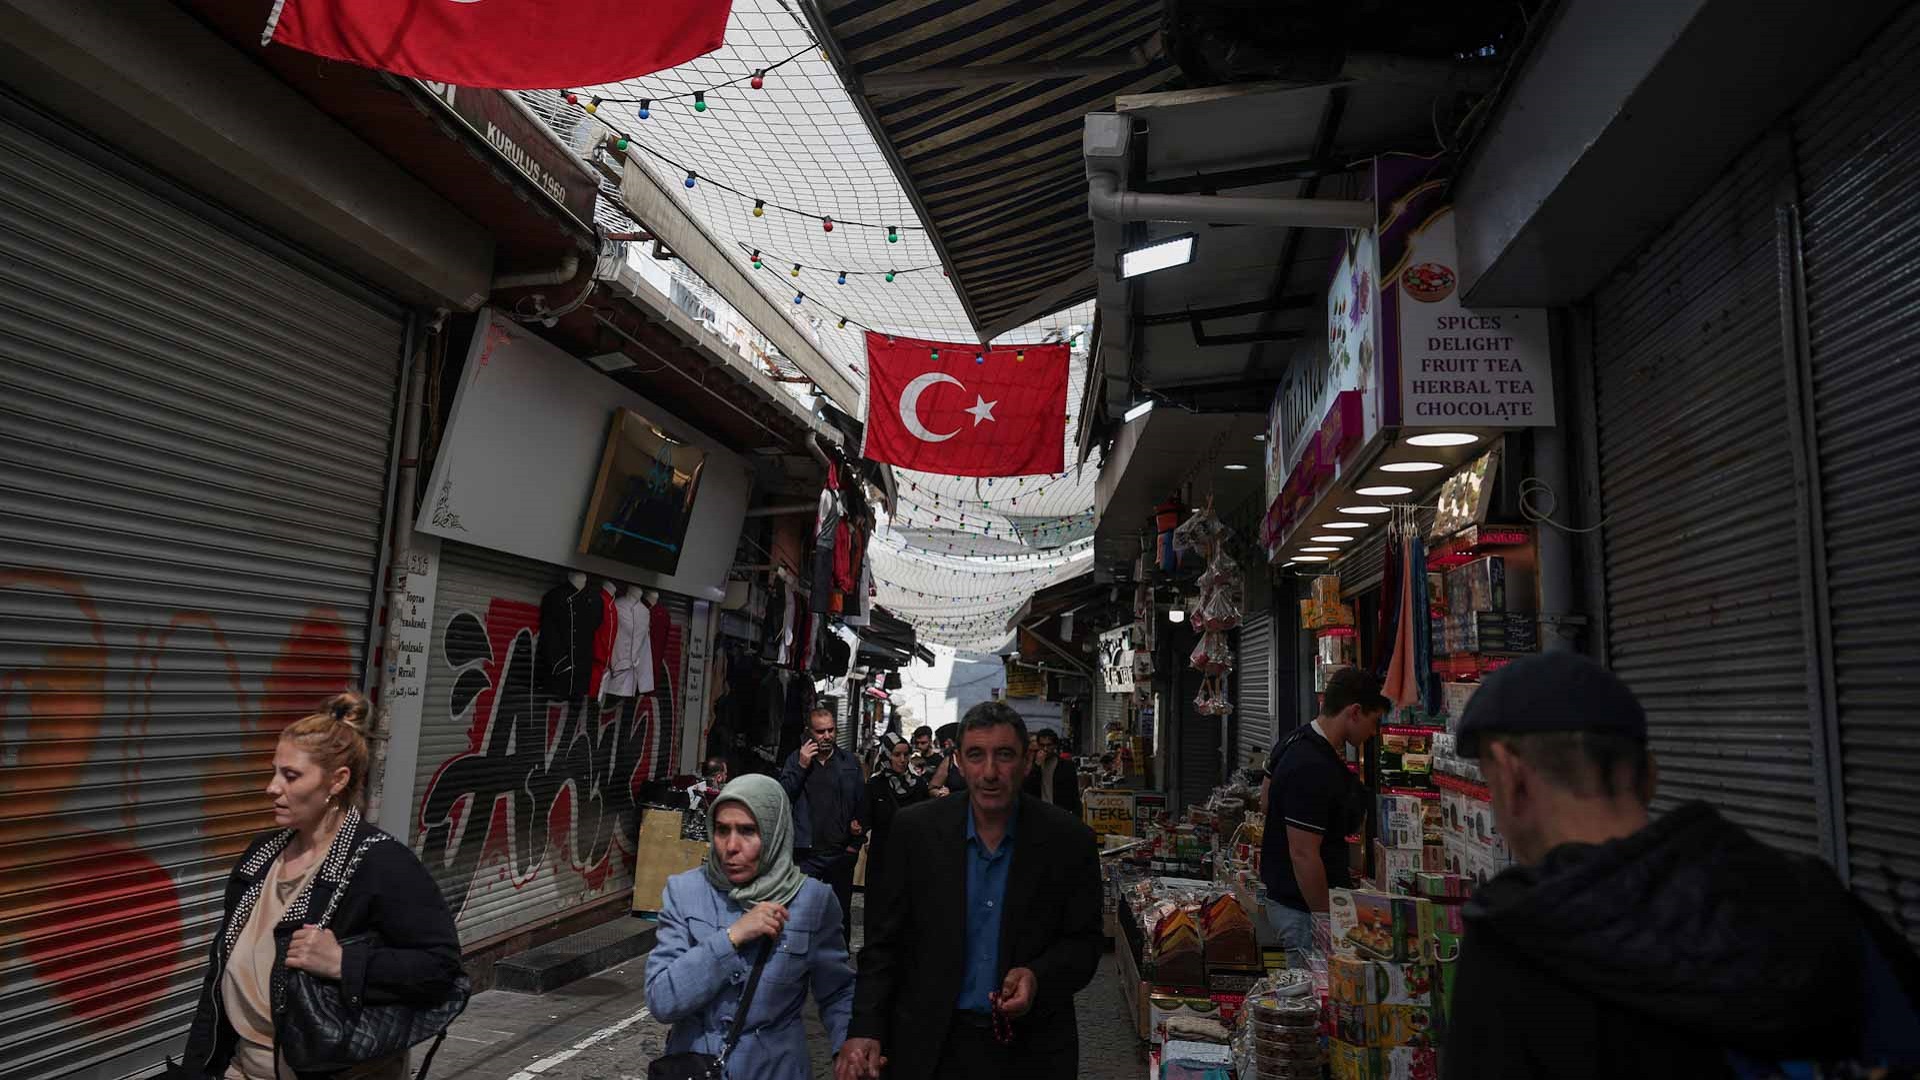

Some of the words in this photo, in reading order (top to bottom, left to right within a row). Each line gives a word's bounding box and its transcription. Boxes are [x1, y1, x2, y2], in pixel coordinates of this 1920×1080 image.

[542, 171, 566, 203] 1960
[1437, 316, 1502, 330] SPICES
[1428, 337, 1513, 351] DELIGHT
[1421, 358, 1479, 372] FRUIT
[1484, 358, 1522, 372] TEA
[1412, 380, 1491, 394] HERBAL
[1495, 380, 1534, 394] TEA
[1416, 401, 1534, 416] CHOCOLATE
